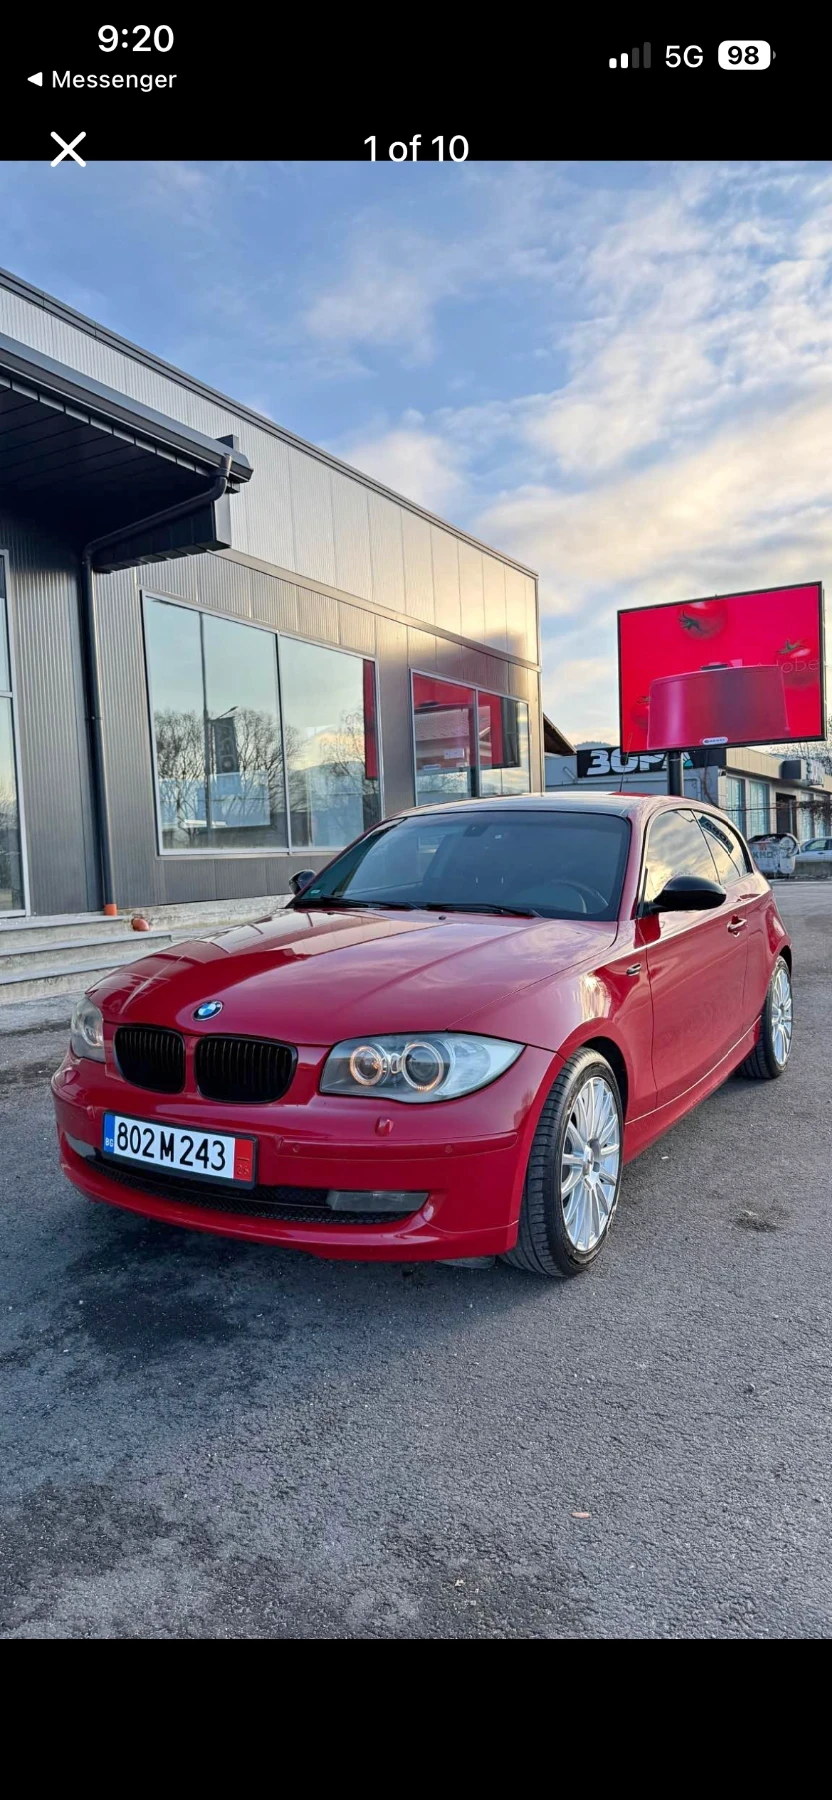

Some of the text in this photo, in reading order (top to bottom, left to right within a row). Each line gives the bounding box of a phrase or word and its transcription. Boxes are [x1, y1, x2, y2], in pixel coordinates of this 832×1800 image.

[105, 1138, 114, 1147] BG
[117, 1122, 225, 1171] 802 M 243
